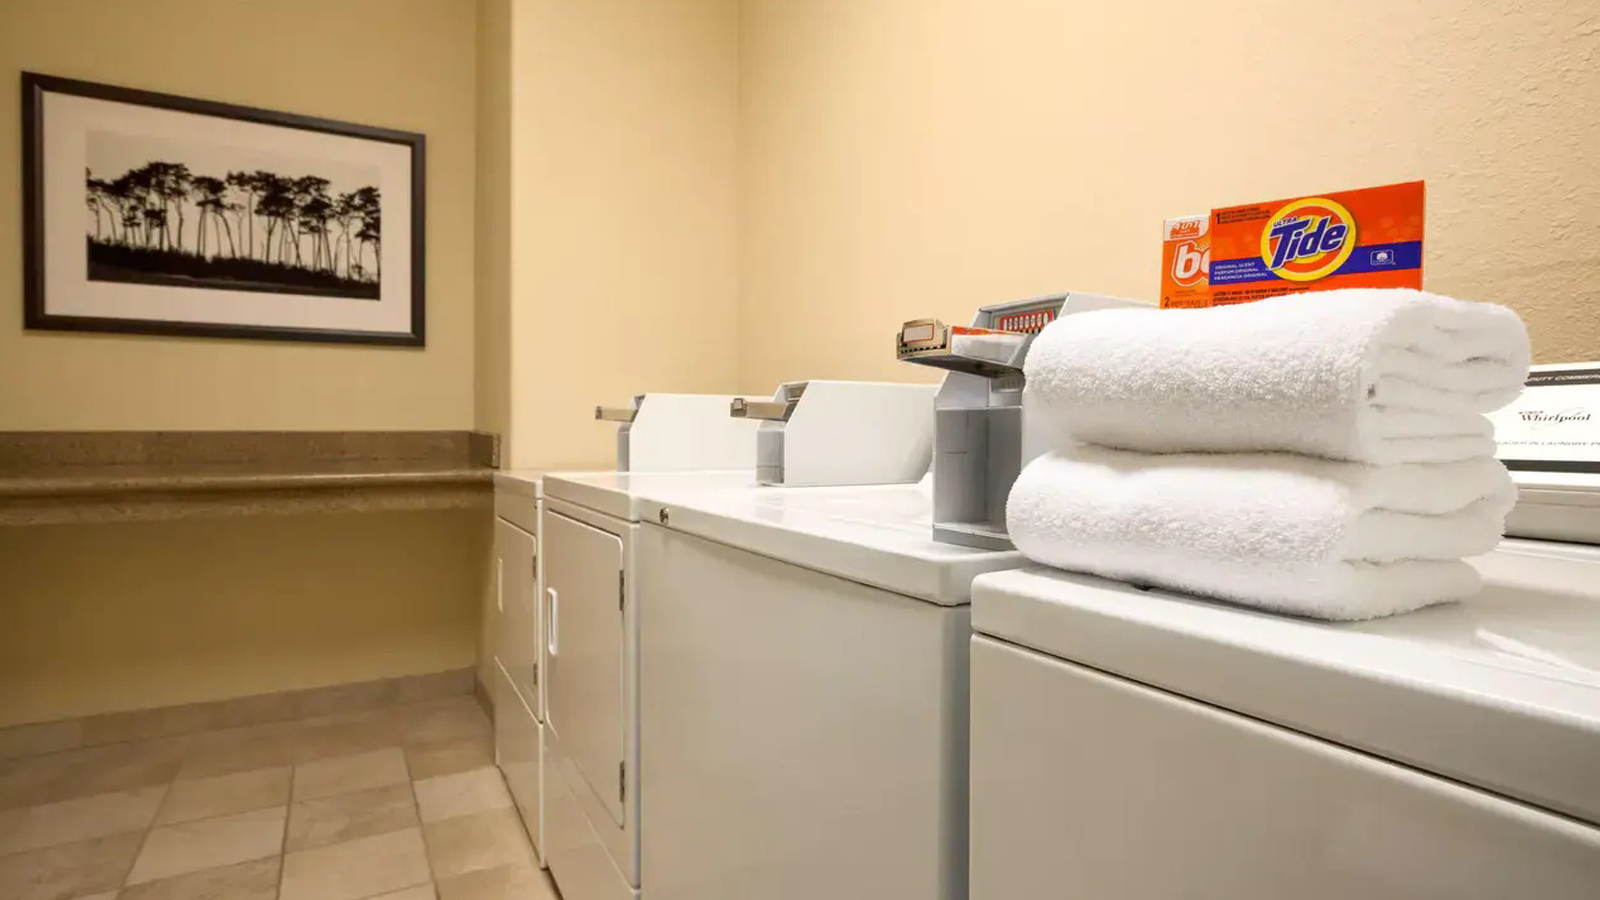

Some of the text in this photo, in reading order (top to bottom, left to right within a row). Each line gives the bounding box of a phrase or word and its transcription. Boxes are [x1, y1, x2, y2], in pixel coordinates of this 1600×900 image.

[1273, 216, 1298, 227] ULTRA
[1268, 216, 1348, 270] Tide
[1518, 411, 1591, 423] Whirlpool
